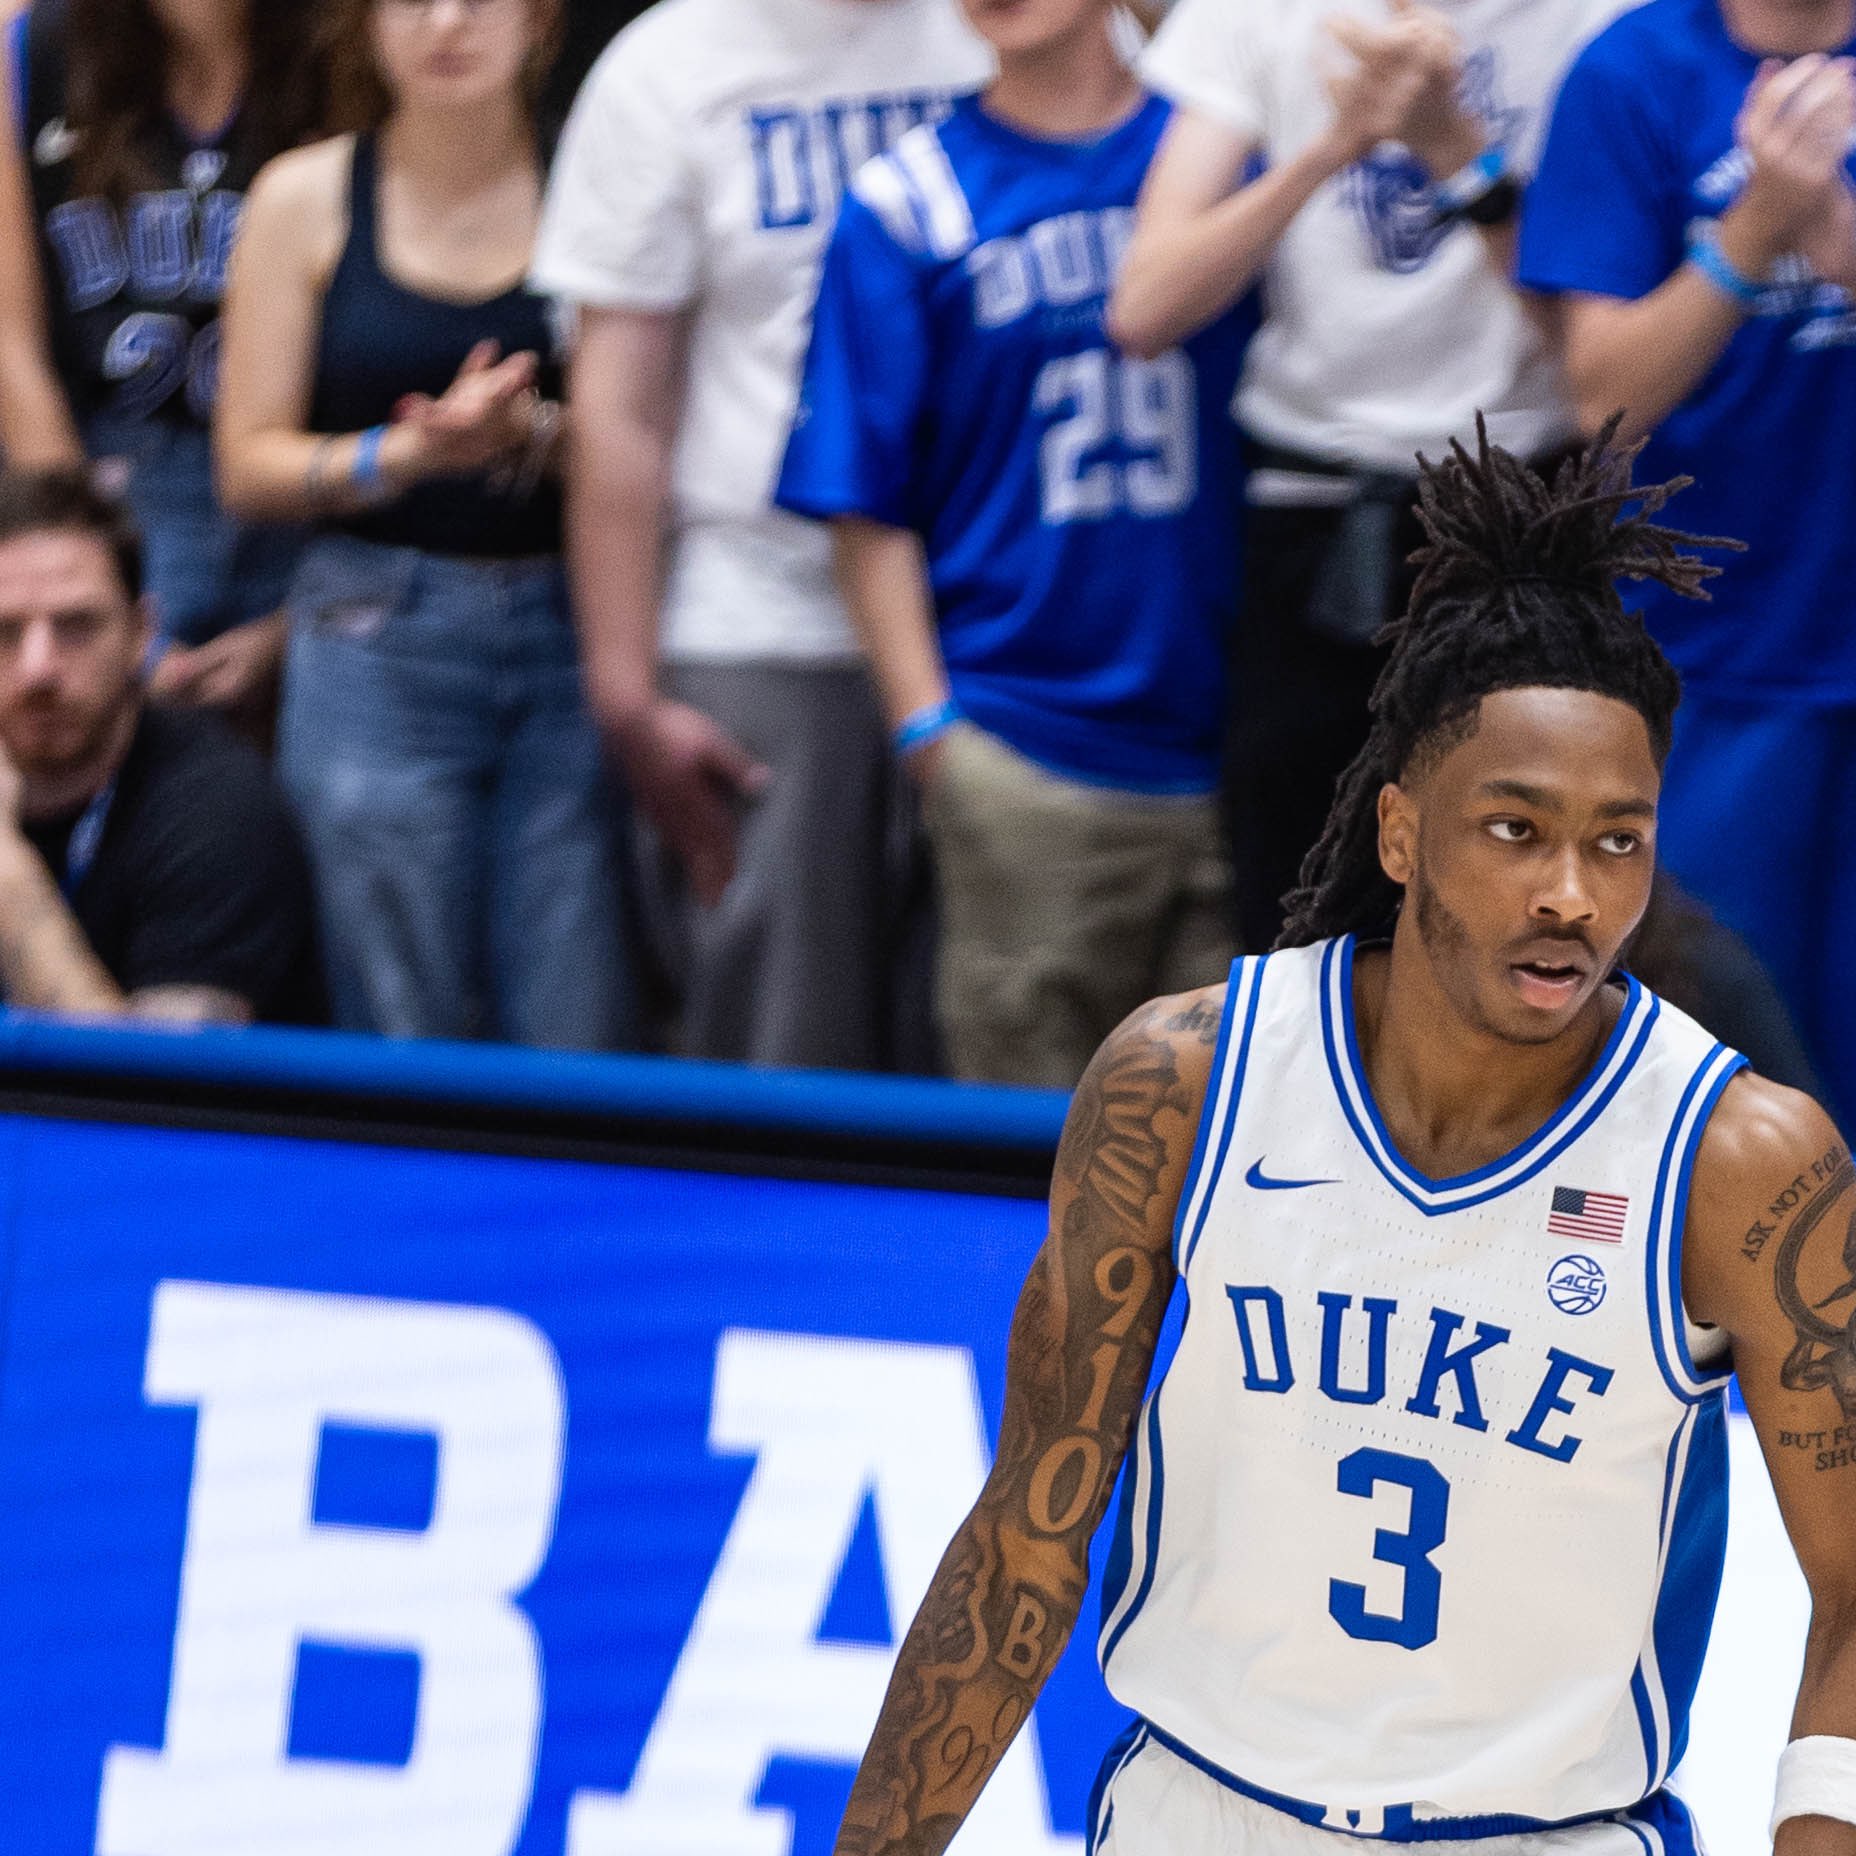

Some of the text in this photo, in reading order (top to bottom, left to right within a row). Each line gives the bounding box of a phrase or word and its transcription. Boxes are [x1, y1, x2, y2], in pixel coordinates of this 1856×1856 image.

[743, 95, 952, 234] DU
[966, 206, 1140, 330] DU
[1031, 347, 1199, 526] 29
[1555, 1273, 1606, 1294] ACC
[1740, 1220, 1777, 1263] ASK
[1769, 1174, 1811, 1220] NOT
[1225, 1283, 1615, 1464] DUKE
[1779, 1430, 1827, 1449] BUT
[1329, 1446, 1451, 1651] 3
